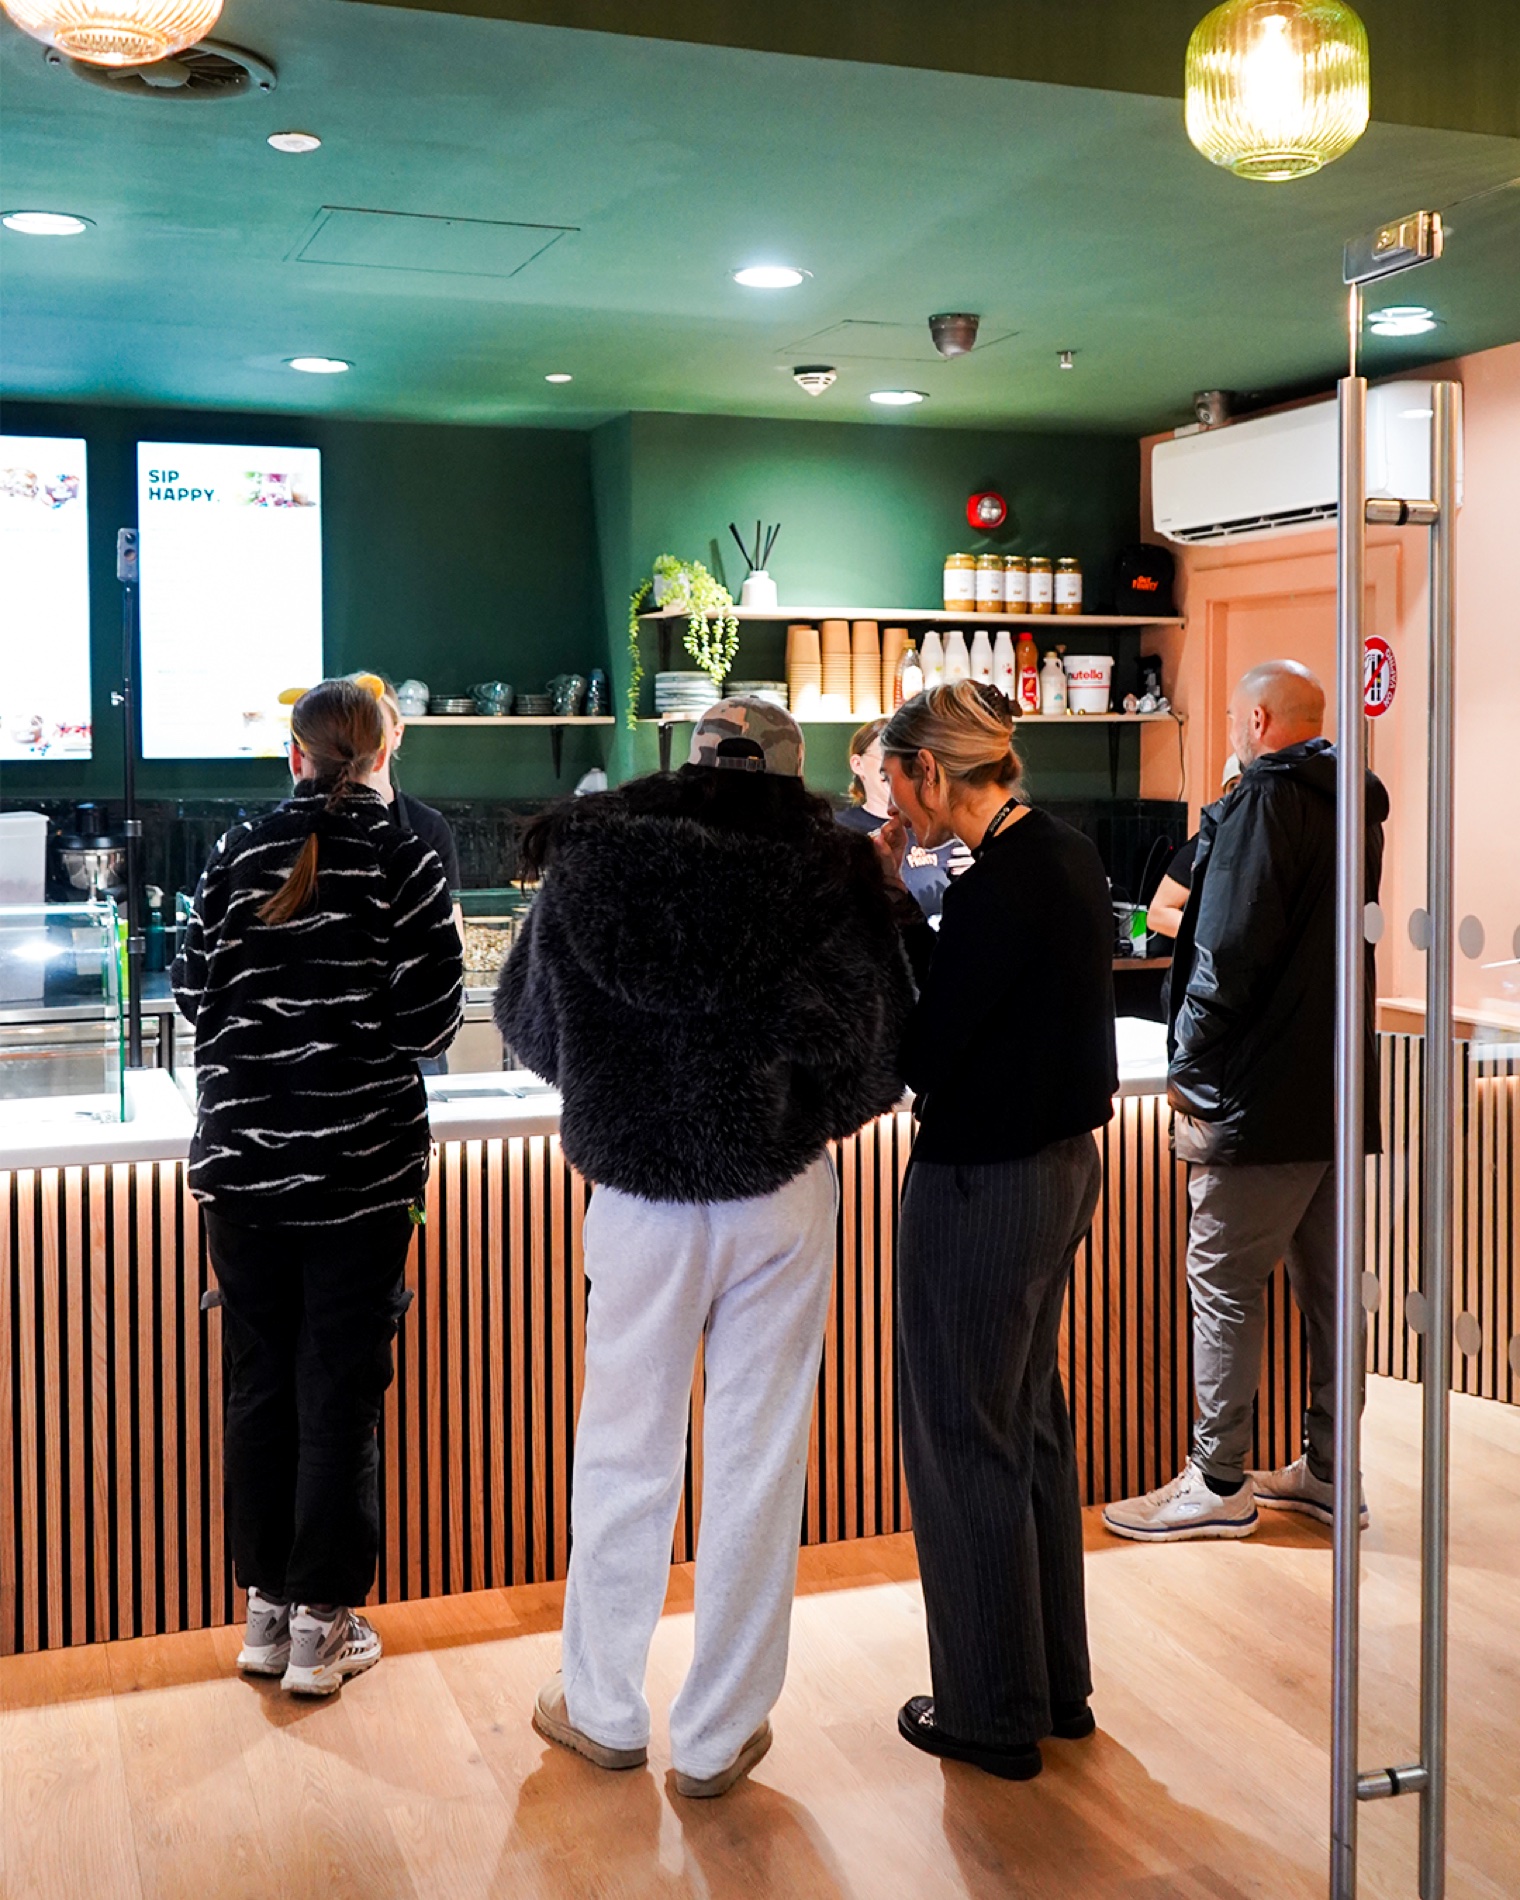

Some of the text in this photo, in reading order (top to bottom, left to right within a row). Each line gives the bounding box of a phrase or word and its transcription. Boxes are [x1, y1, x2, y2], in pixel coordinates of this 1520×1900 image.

[149, 469, 180, 483] SIP
[1067, 668, 1103, 681] nutella
[1383, 691, 1394, 708] NO
